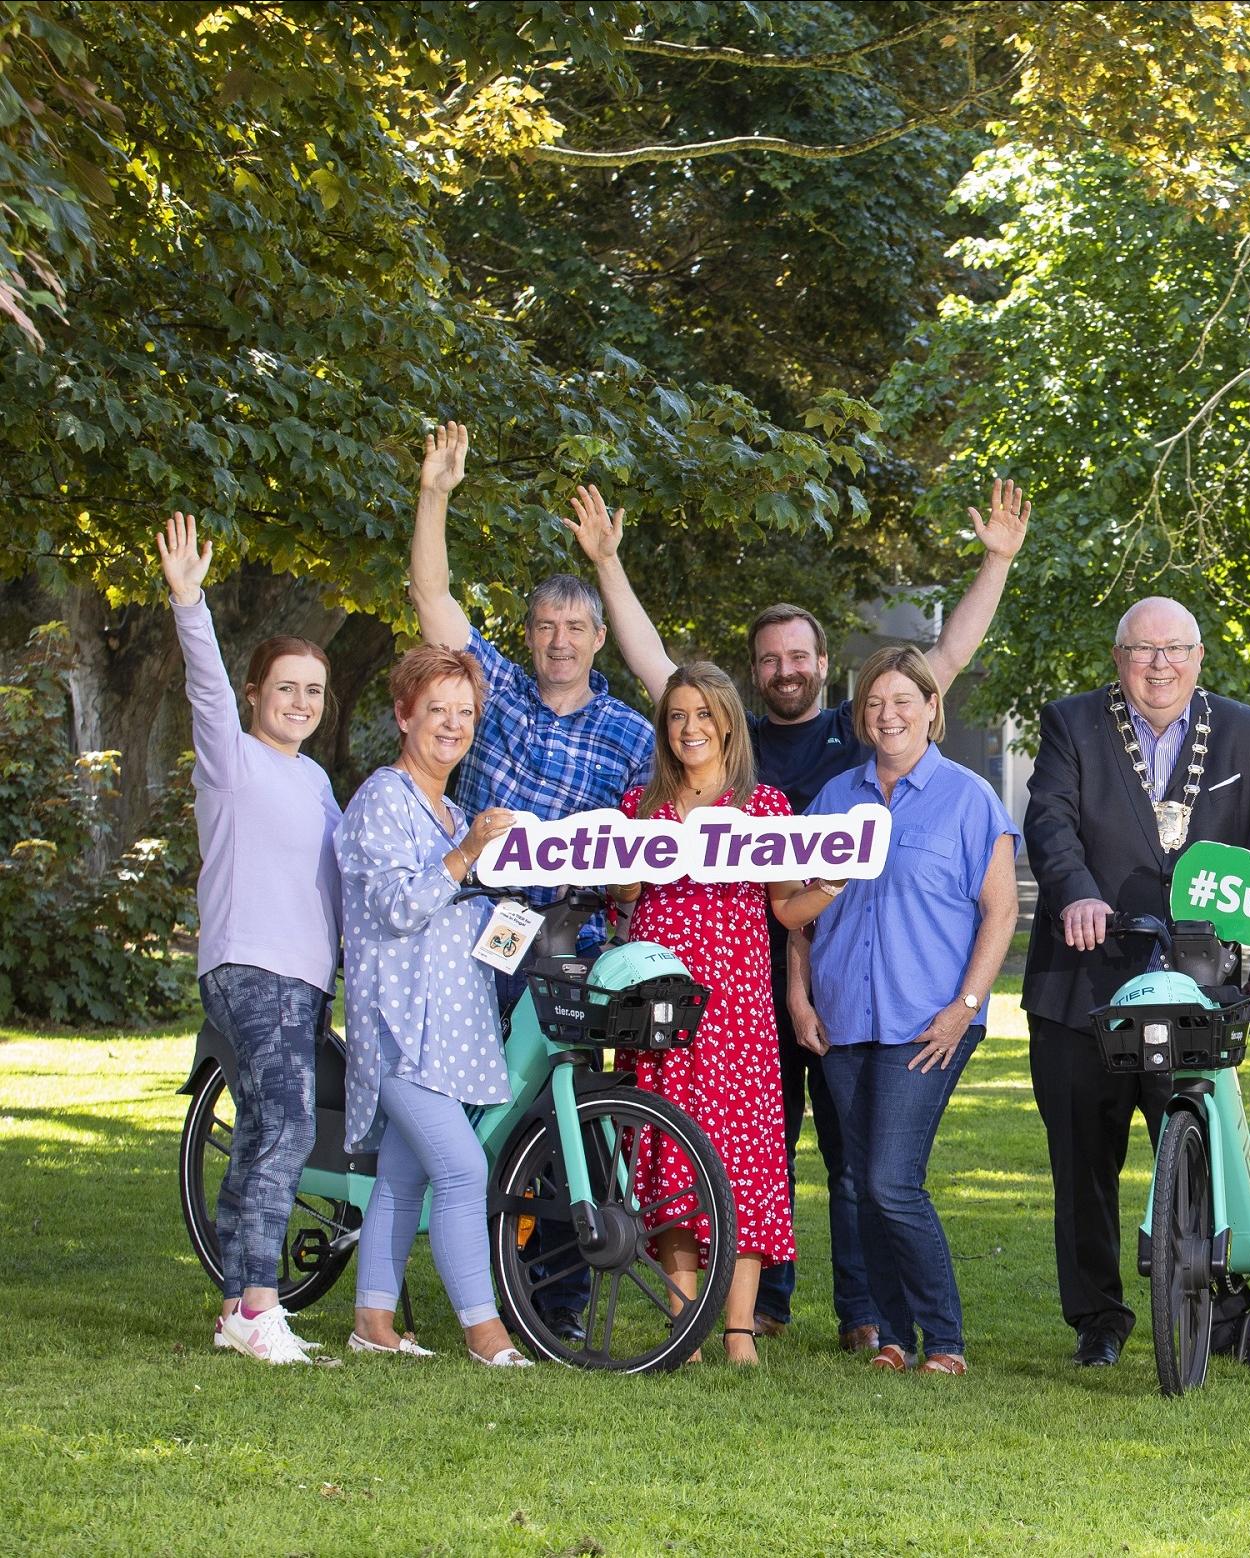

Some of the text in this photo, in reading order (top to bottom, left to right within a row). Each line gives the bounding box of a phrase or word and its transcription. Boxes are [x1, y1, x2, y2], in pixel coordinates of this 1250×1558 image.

[493, 820, 876, 871] Active Travel
[1116, 986, 1155, 1006] TIER
[554, 1005, 585, 1021] tier.app
